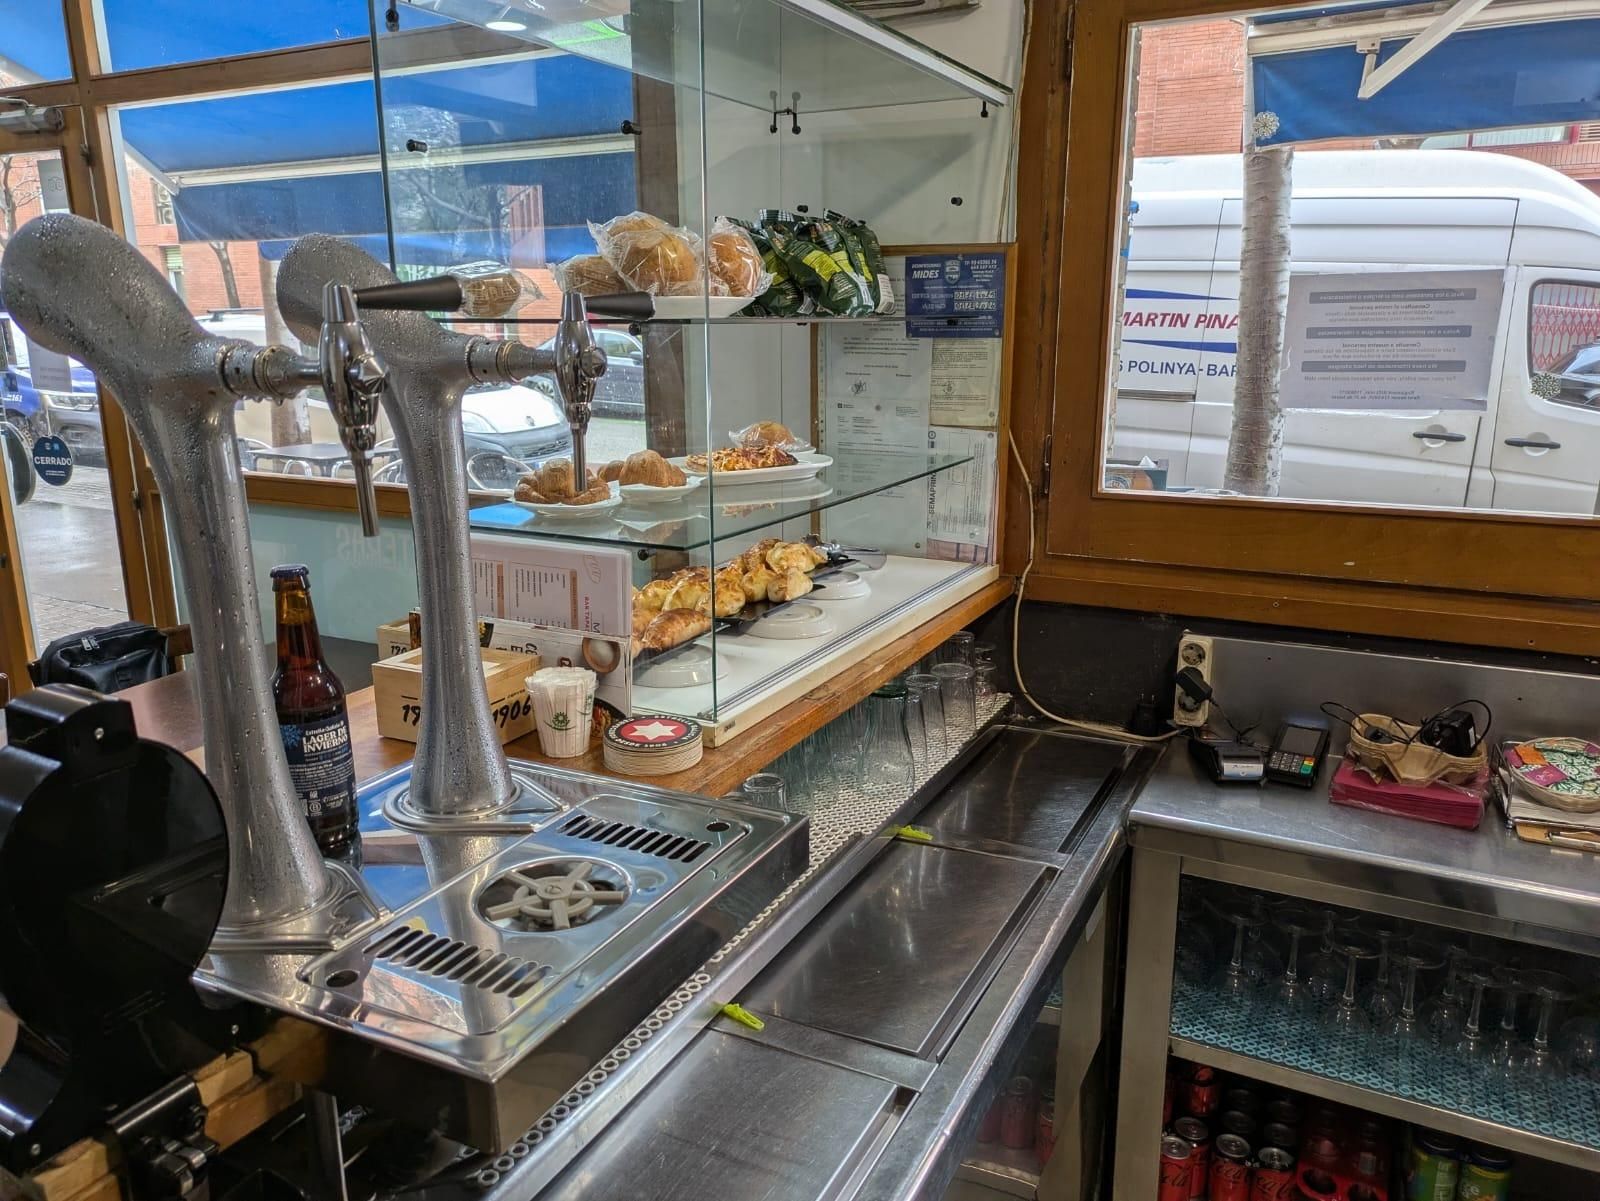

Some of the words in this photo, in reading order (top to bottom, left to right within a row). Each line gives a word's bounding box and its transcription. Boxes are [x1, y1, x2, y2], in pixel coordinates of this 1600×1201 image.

[912, 270, 940, 279] MIDES
[1122, 312, 1190, 328] MARTIN
[1128, 361, 1196, 375] POLINYA
[34, 456, 72, 466] CERRADO
[492, 694, 532, 729] 1906
[302, 731, 337, 745] LAGER
[337, 725, 347, 736] DE
[303, 734, 348, 753] INVIERNO
